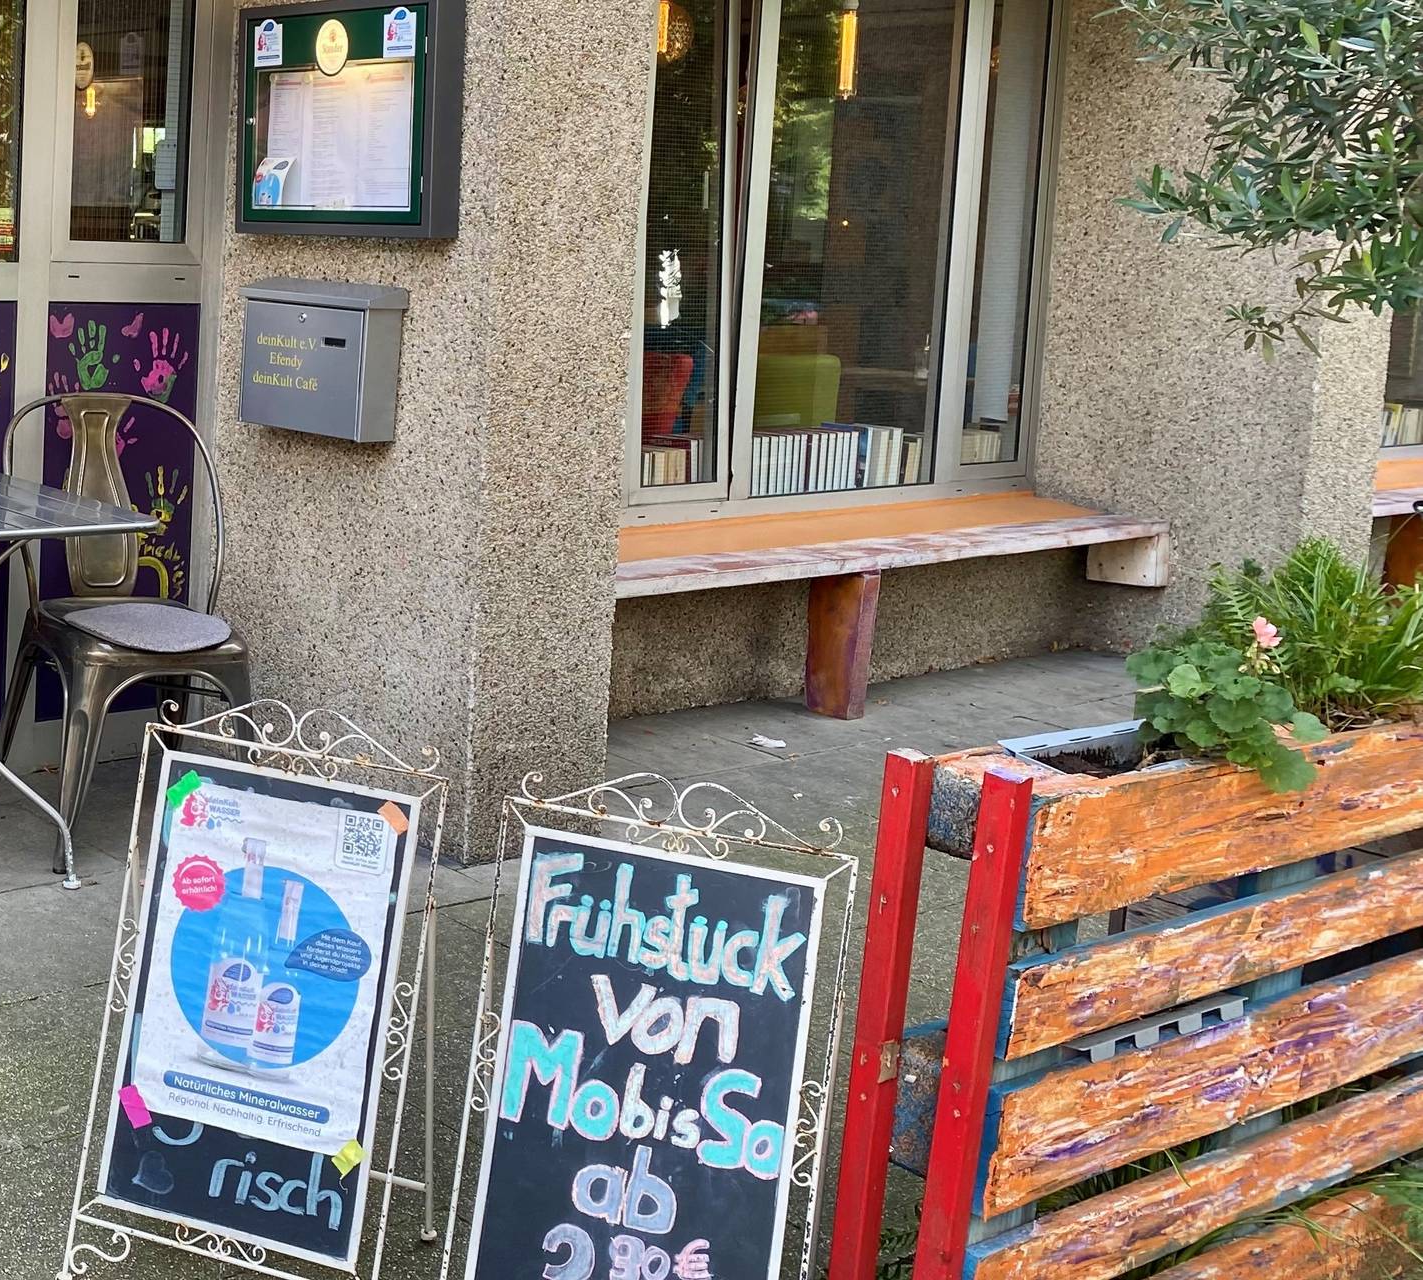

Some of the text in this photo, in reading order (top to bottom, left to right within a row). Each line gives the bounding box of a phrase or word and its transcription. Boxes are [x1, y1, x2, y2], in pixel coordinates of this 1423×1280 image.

[257, 332, 297, 349] deinKult
[269, 352, 304, 371] Efendy
[252, 371, 318, 392] deinKult Café
[209, 805, 241, 817] WASSER
[192, 876, 216, 884] sofort
[526, 851, 807, 1002] Frühstück
[173, 1075, 321, 1119] Natürliches Mineralwasser
[267, 1116, 322, 1137] Erfrischend
[208, 1151, 343, 1232] risch
[572, 1144, 677, 1235] ab
